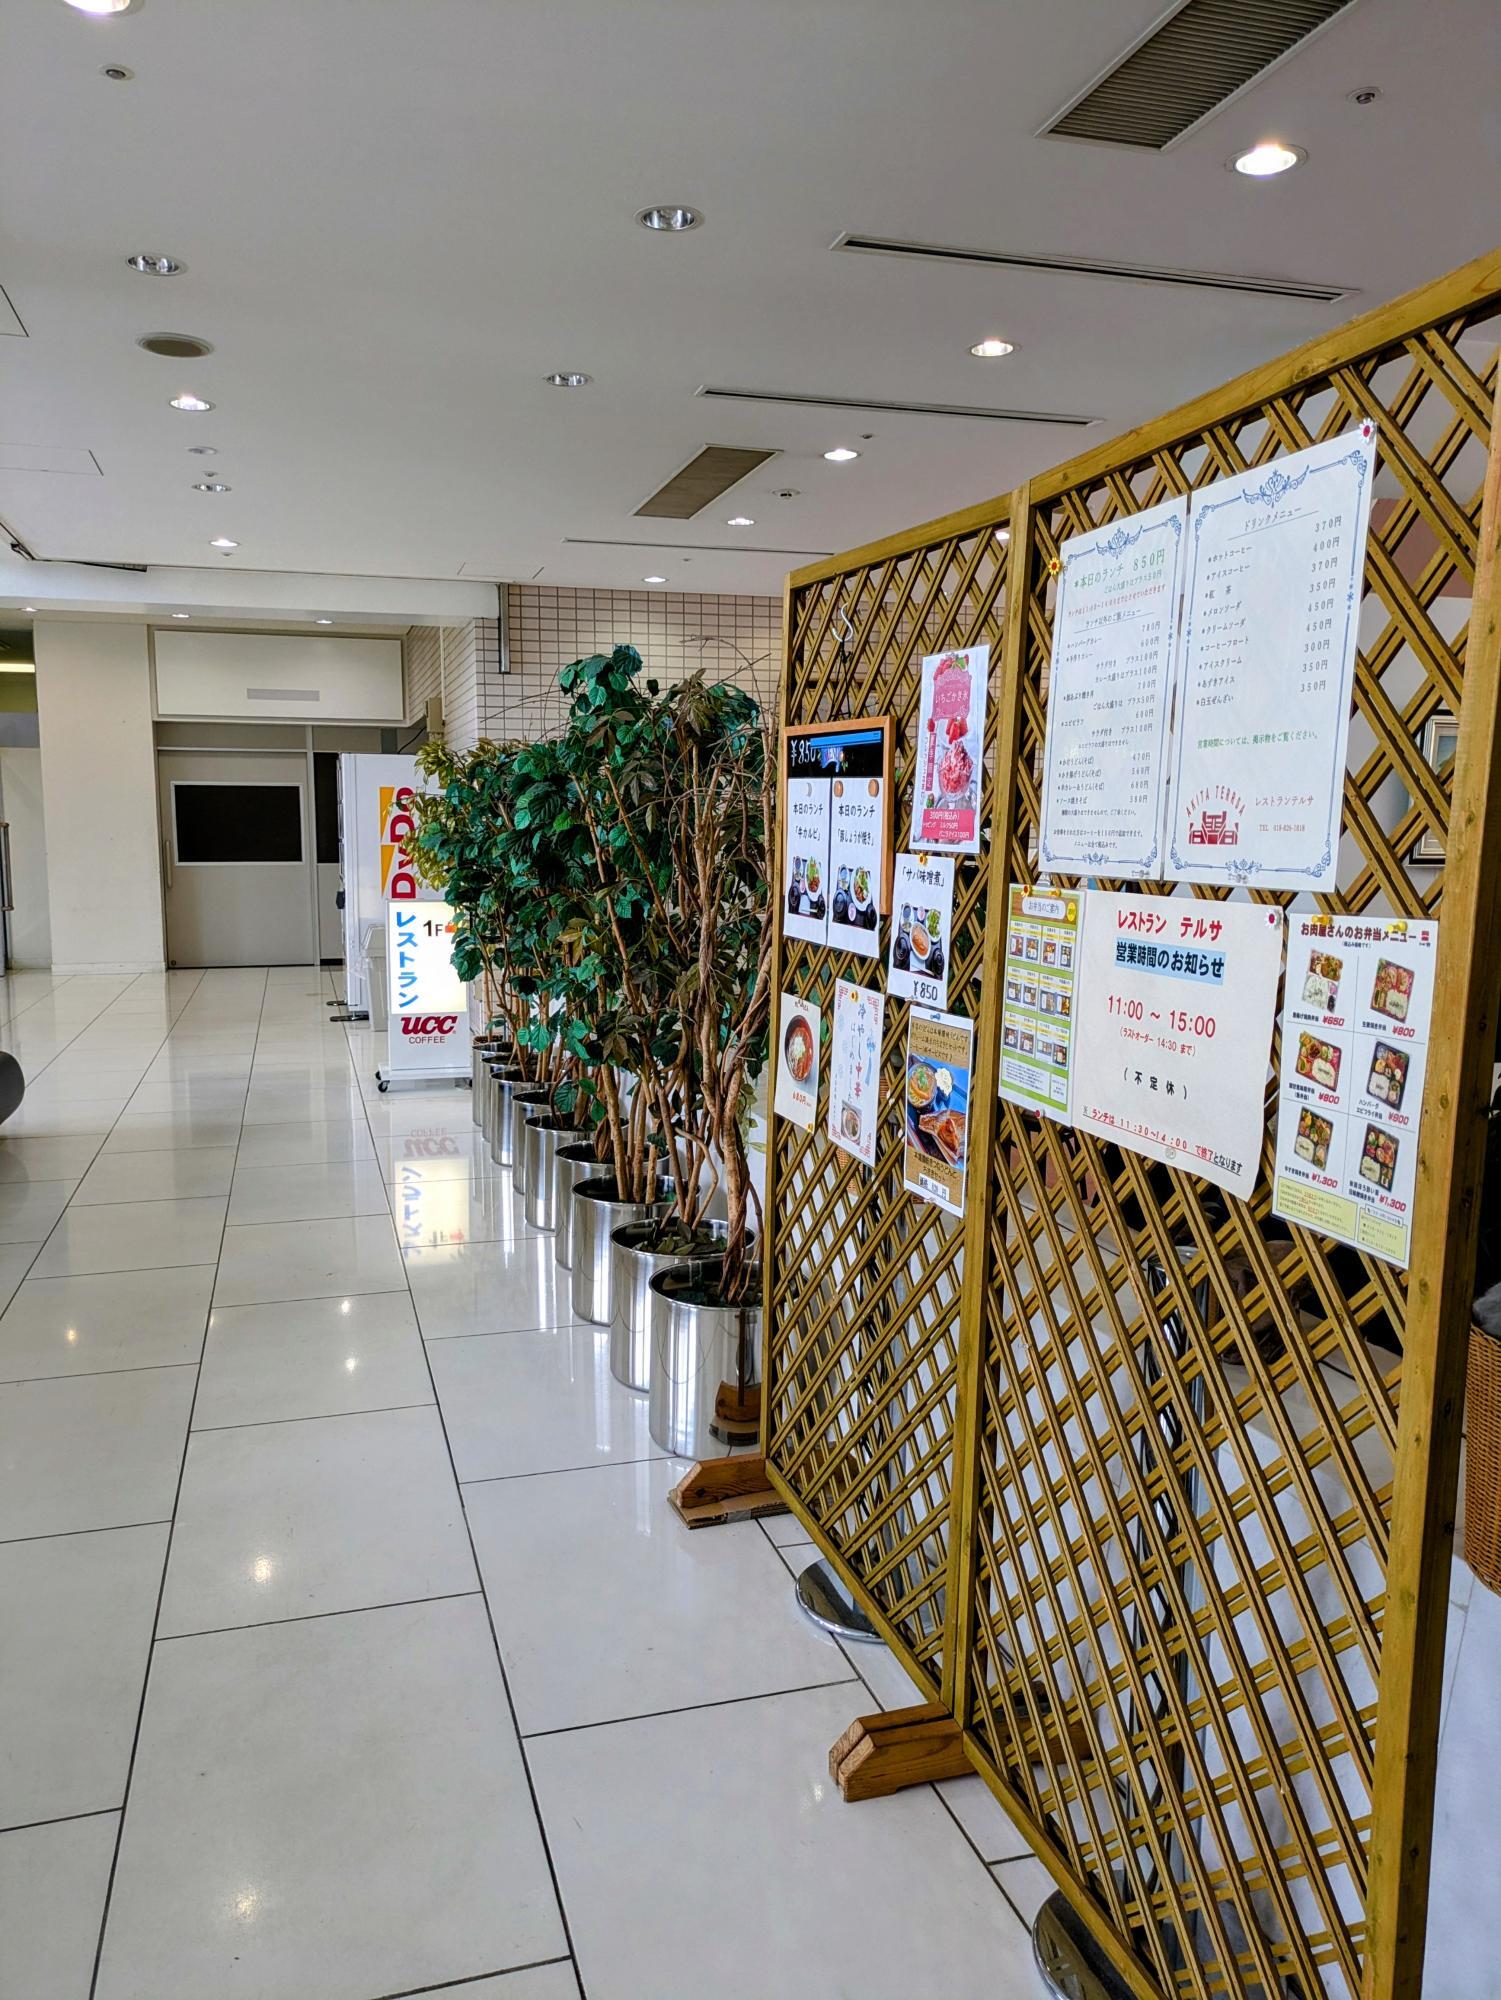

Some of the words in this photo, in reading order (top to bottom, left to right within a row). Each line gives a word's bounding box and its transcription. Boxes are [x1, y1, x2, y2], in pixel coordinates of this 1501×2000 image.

[1245, 507, 1302, 531] ドリンクメニュー
[1212, 546, 1252, 562] ホットコーヒー
[1315, 515, 1342, 533] 370円
[1080, 562, 1124, 587] 本日のランチ
[1133, 548, 1165, 571] 850円
[1211, 565, 1251, 581] アイスコーヒー
[1313, 536, 1340, 552] 400円
[1311, 557, 1338, 573] 370円
[1207, 601, 1242, 617] メロンソーダ
[1309, 578, 1336, 593] 350円
[1206, 618, 1246, 635] クリームソーダ
[1307, 598, 1334, 613] 450円
[1205, 636, 1249, 651] コーヒーフロート
[1306, 618, 1332, 633] 450円
[1203, 656, 1242, 671] アイスクリーム
[1304, 639, 1330, 653] 300円
[1302, 659, 1328, 673] 350円
[1200, 694, 1234, 707] 白玉ぜんざい
[1300, 680, 1326, 693] 350円
[793, 802, 823, 816] 本日のランチ
[838, 804, 876, 818] 本日のランチ
[1255, 794, 1314, 807] レストランテルサ
[423, 920, 443, 937] 1F
[1117, 910, 1167, 934] レストラン
[1180, 916, 1223, 941] テルサ
[1300, 922, 1417, 943] お肉屋さんのお弁当メニュー
[396, 911, 418, 1008] レストラン
[1116, 941, 1224, 978] 営業時間のお知らせ
[913, 980, 938, 1001] ¥850
[1108, 995, 1143, 1021] 11:00
[1169, 1010, 1216, 1038] 15:00
[408, 1036, 446, 1044] COFFEE
[1157, 1037, 1177, 1053] 14:30
[1091, 1108, 1115, 1125] ランチは
[1195, 1144, 1243, 1175] で終了となります
